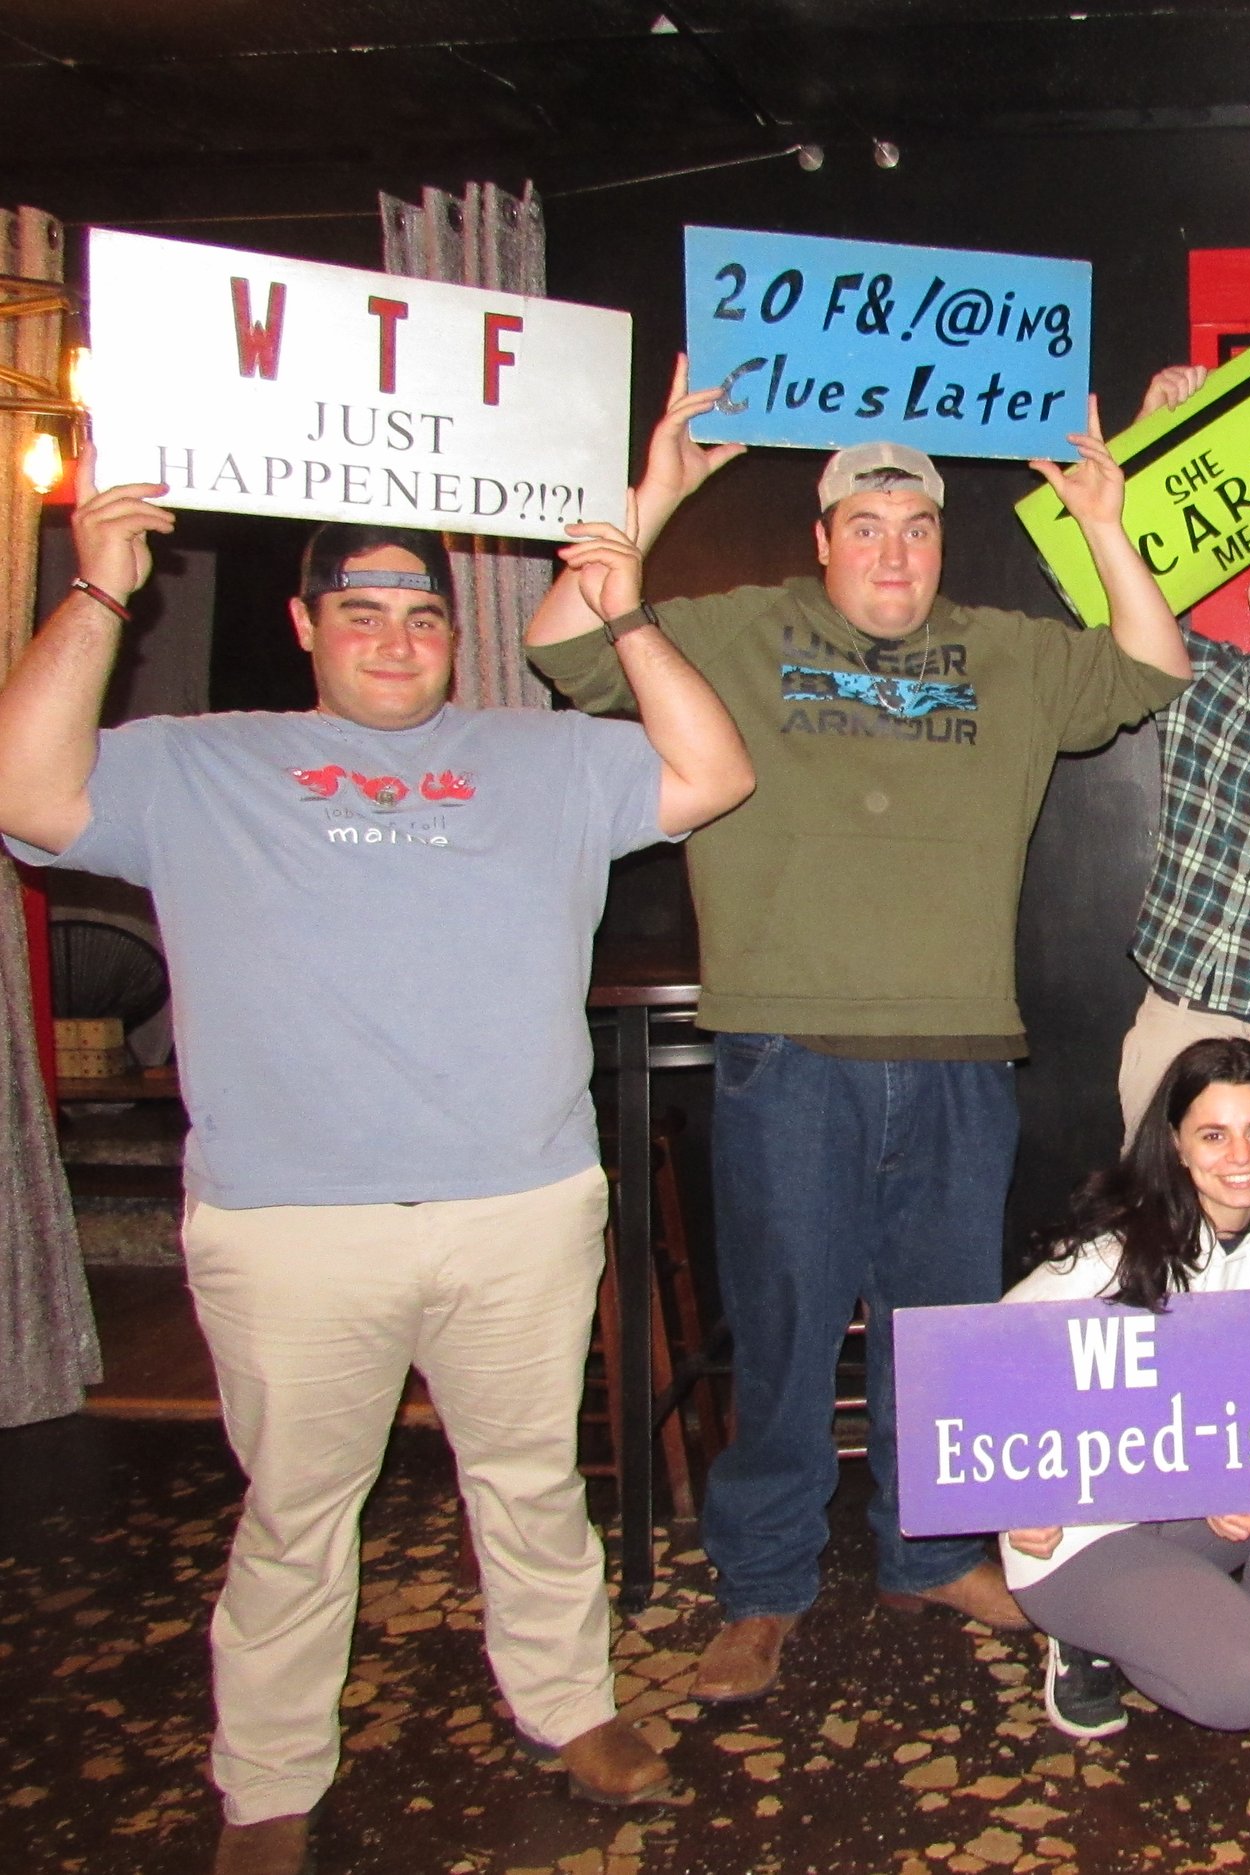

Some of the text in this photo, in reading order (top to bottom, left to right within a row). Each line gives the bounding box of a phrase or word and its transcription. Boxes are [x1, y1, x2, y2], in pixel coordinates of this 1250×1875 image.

[713, 262, 804, 325] 20
[715, 353, 1066, 425] Clues Later
[307, 401, 454, 454] JUST
[156, 445, 586, 524] HAPPENED?!?!
[1165, 449, 1225, 504] SHE
[327, 826, 449, 849] maine
[1067, 1315, 1158, 1391] WE
